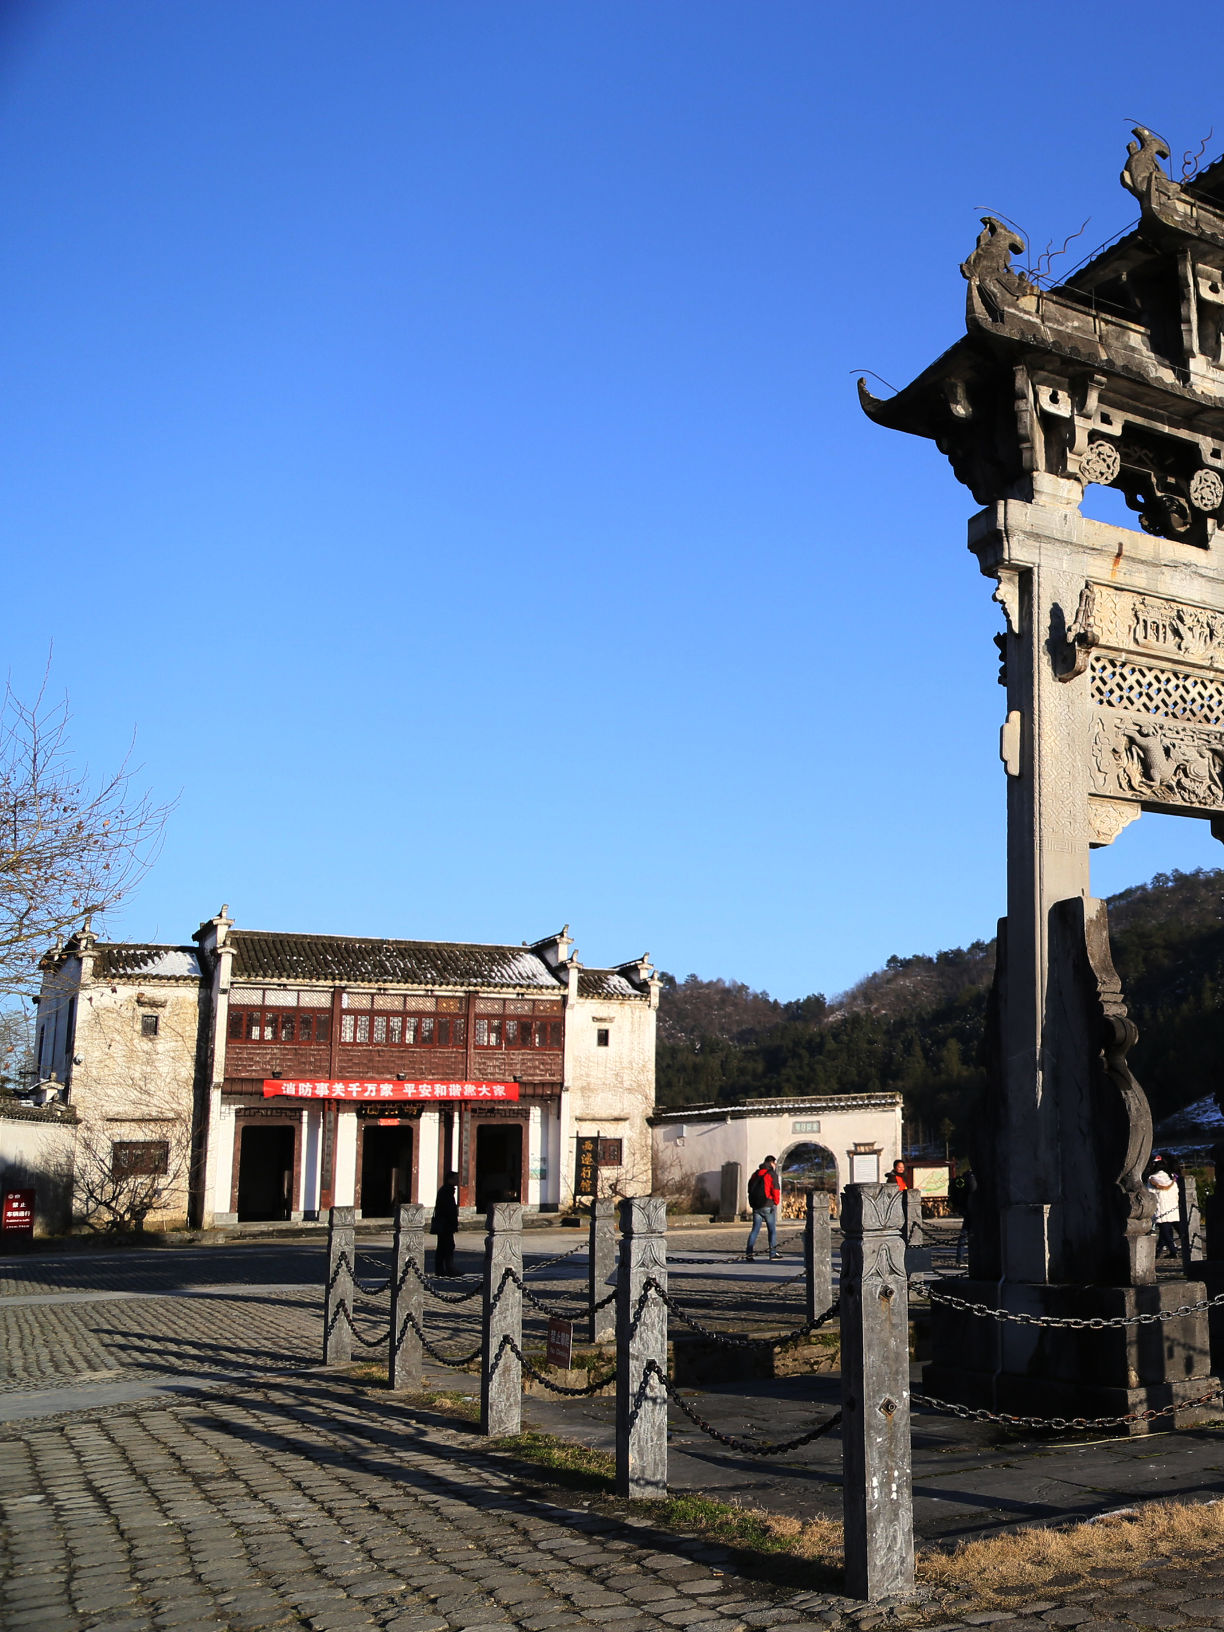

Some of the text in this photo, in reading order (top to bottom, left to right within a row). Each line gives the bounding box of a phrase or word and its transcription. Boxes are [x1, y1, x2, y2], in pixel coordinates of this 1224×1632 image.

[281, 1082, 394, 1097] 消防事关千万家
